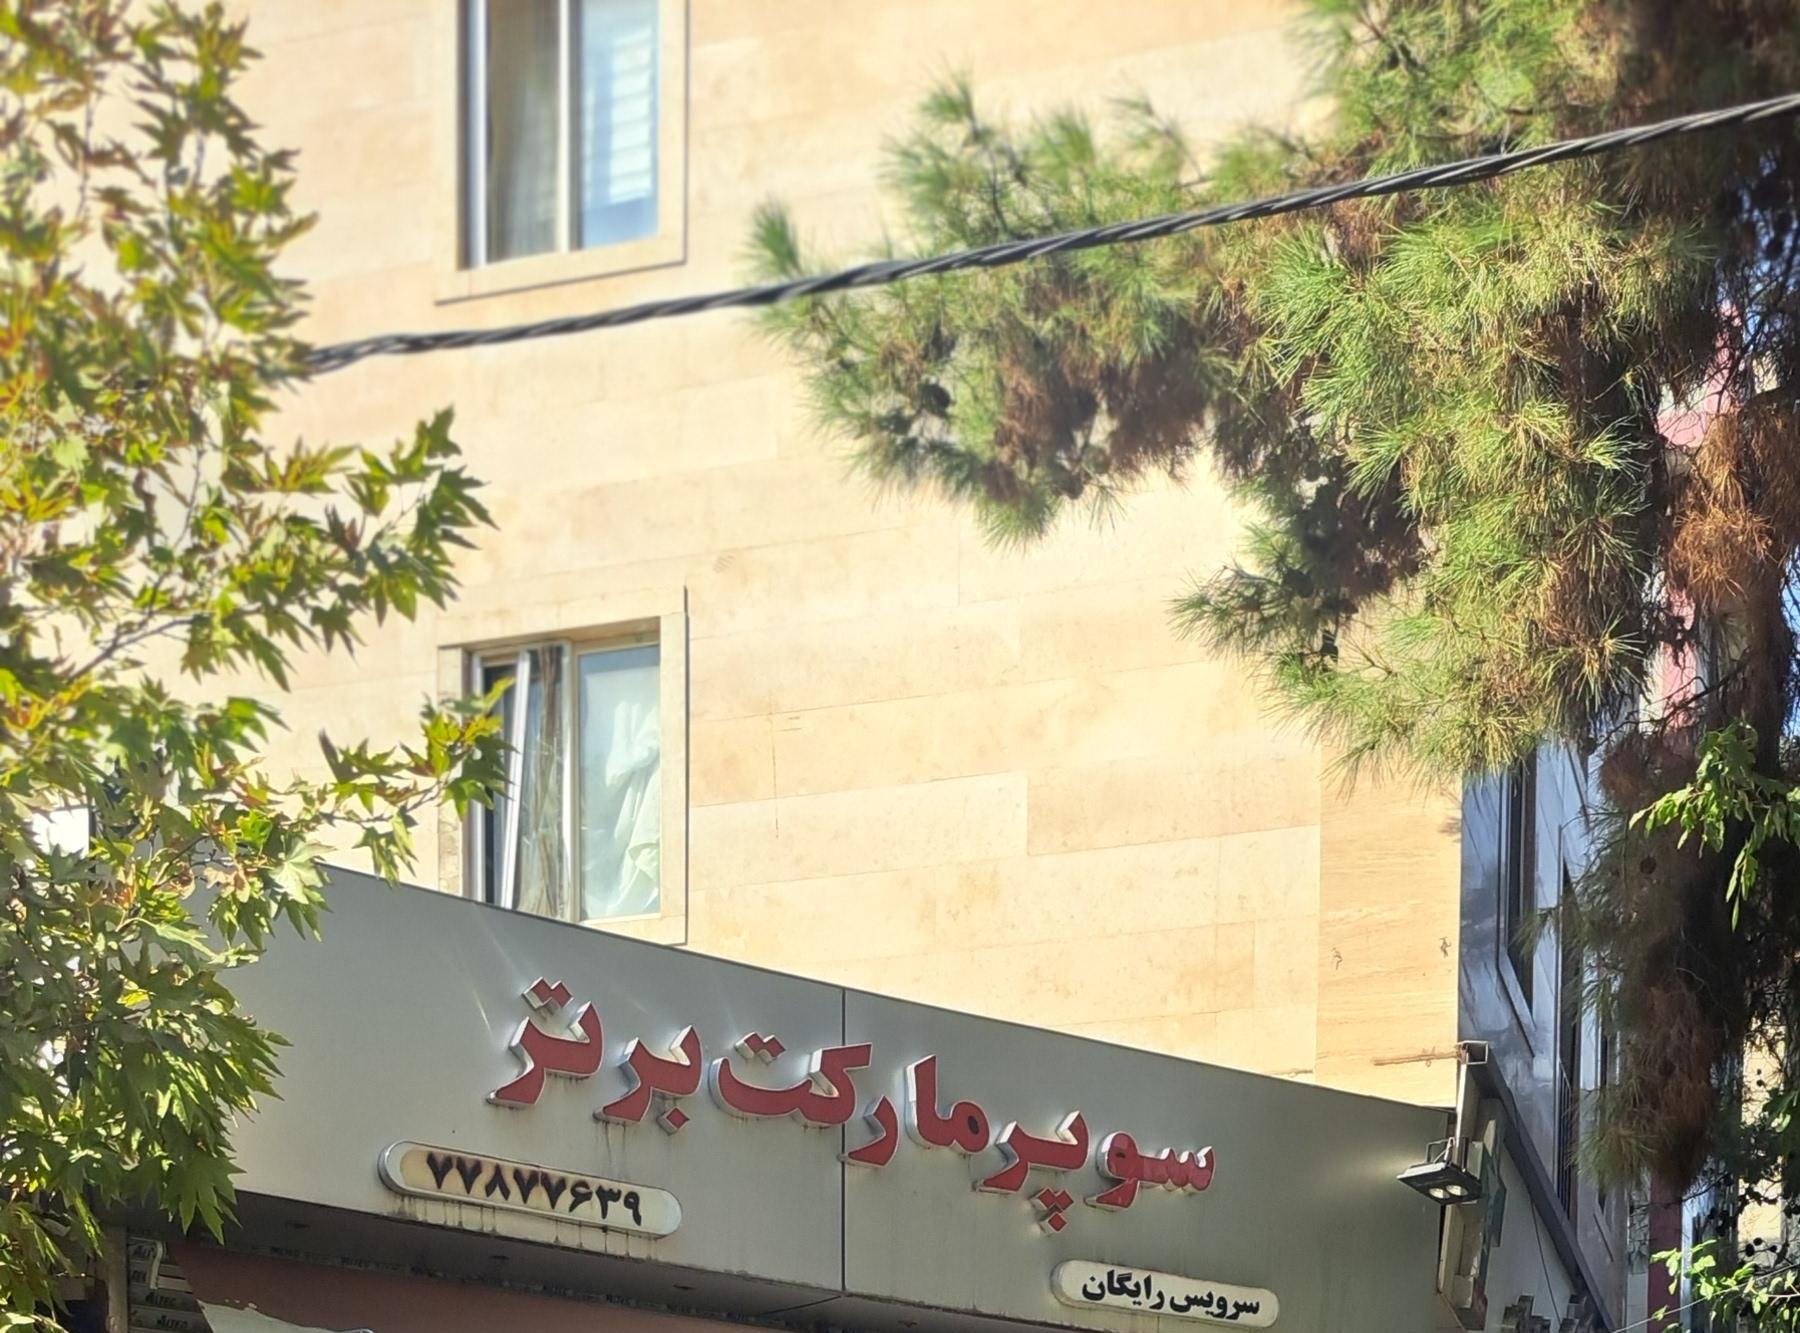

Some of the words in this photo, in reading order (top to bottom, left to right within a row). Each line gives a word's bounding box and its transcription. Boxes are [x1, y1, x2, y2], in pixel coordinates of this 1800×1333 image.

[487, 977, 703, 1134] برتر
[425, 1152, 642, 1226] ۷۷۸۷۷۶۳۹
[1081, 1269, 1165, 1311] رایگان
[1169, 1288, 1261, 1321] سرویس
